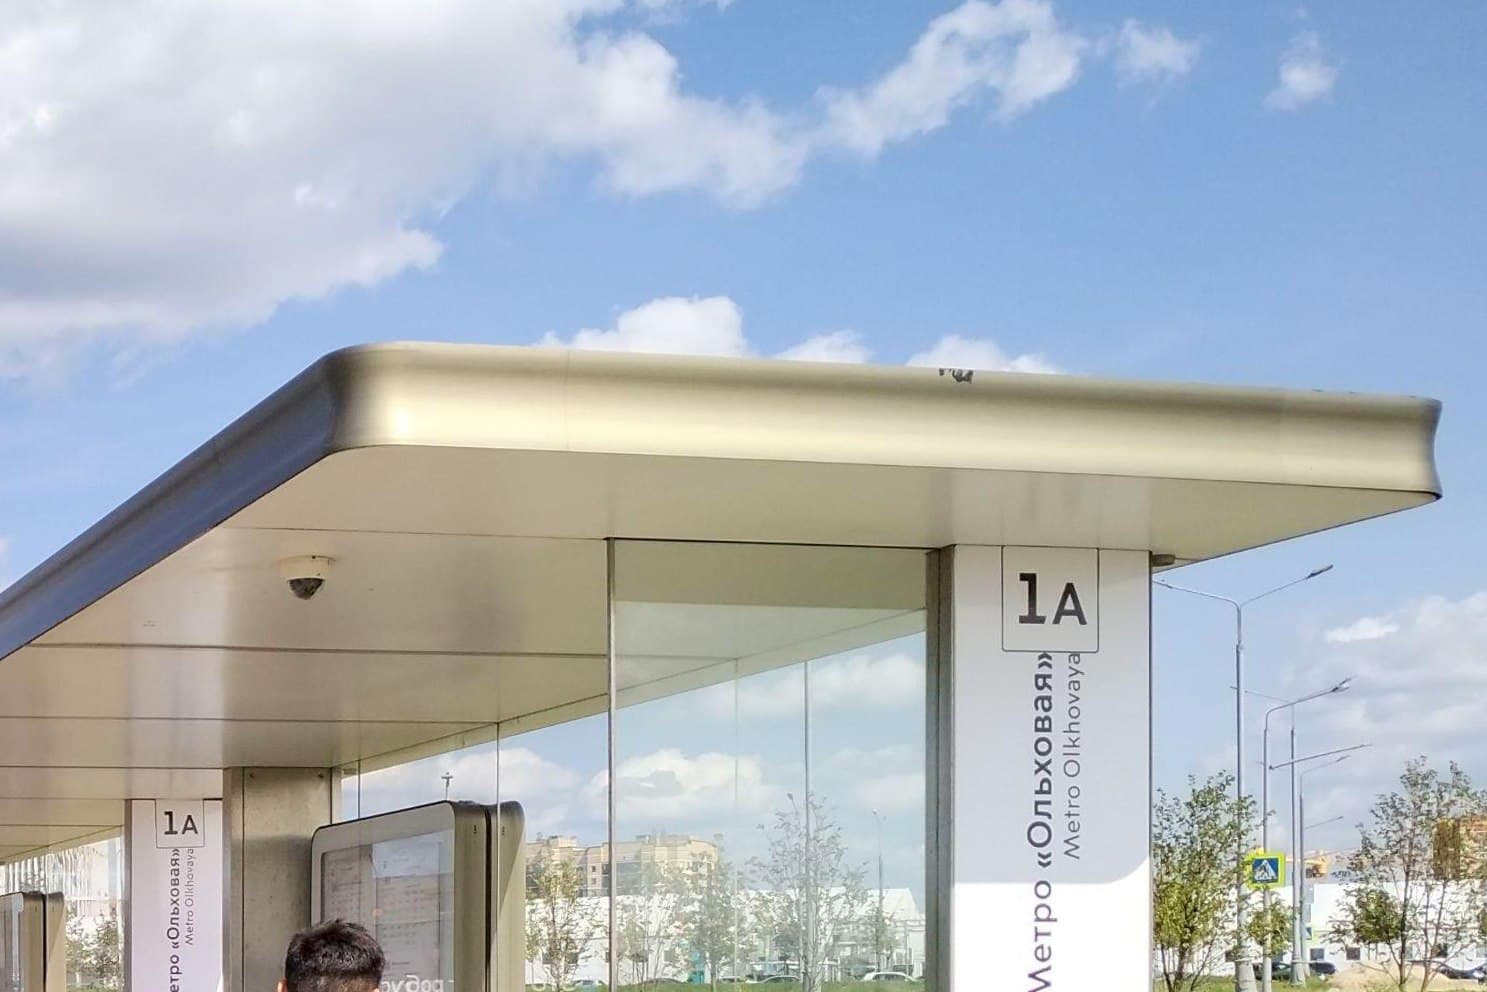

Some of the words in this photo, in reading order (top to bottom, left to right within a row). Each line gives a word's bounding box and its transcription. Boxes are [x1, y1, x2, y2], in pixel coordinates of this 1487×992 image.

[1063, 653, 1087, 778] Olkhovaya
[1026, 652, 1054, 869] «Ольховая»
[1063, 785, 1082, 860] Metro
[167, 849, 181, 949] «Ольховая»
[185, 849, 197, 907] Olkhovaya
[185, 909, 194, 946] Metro
